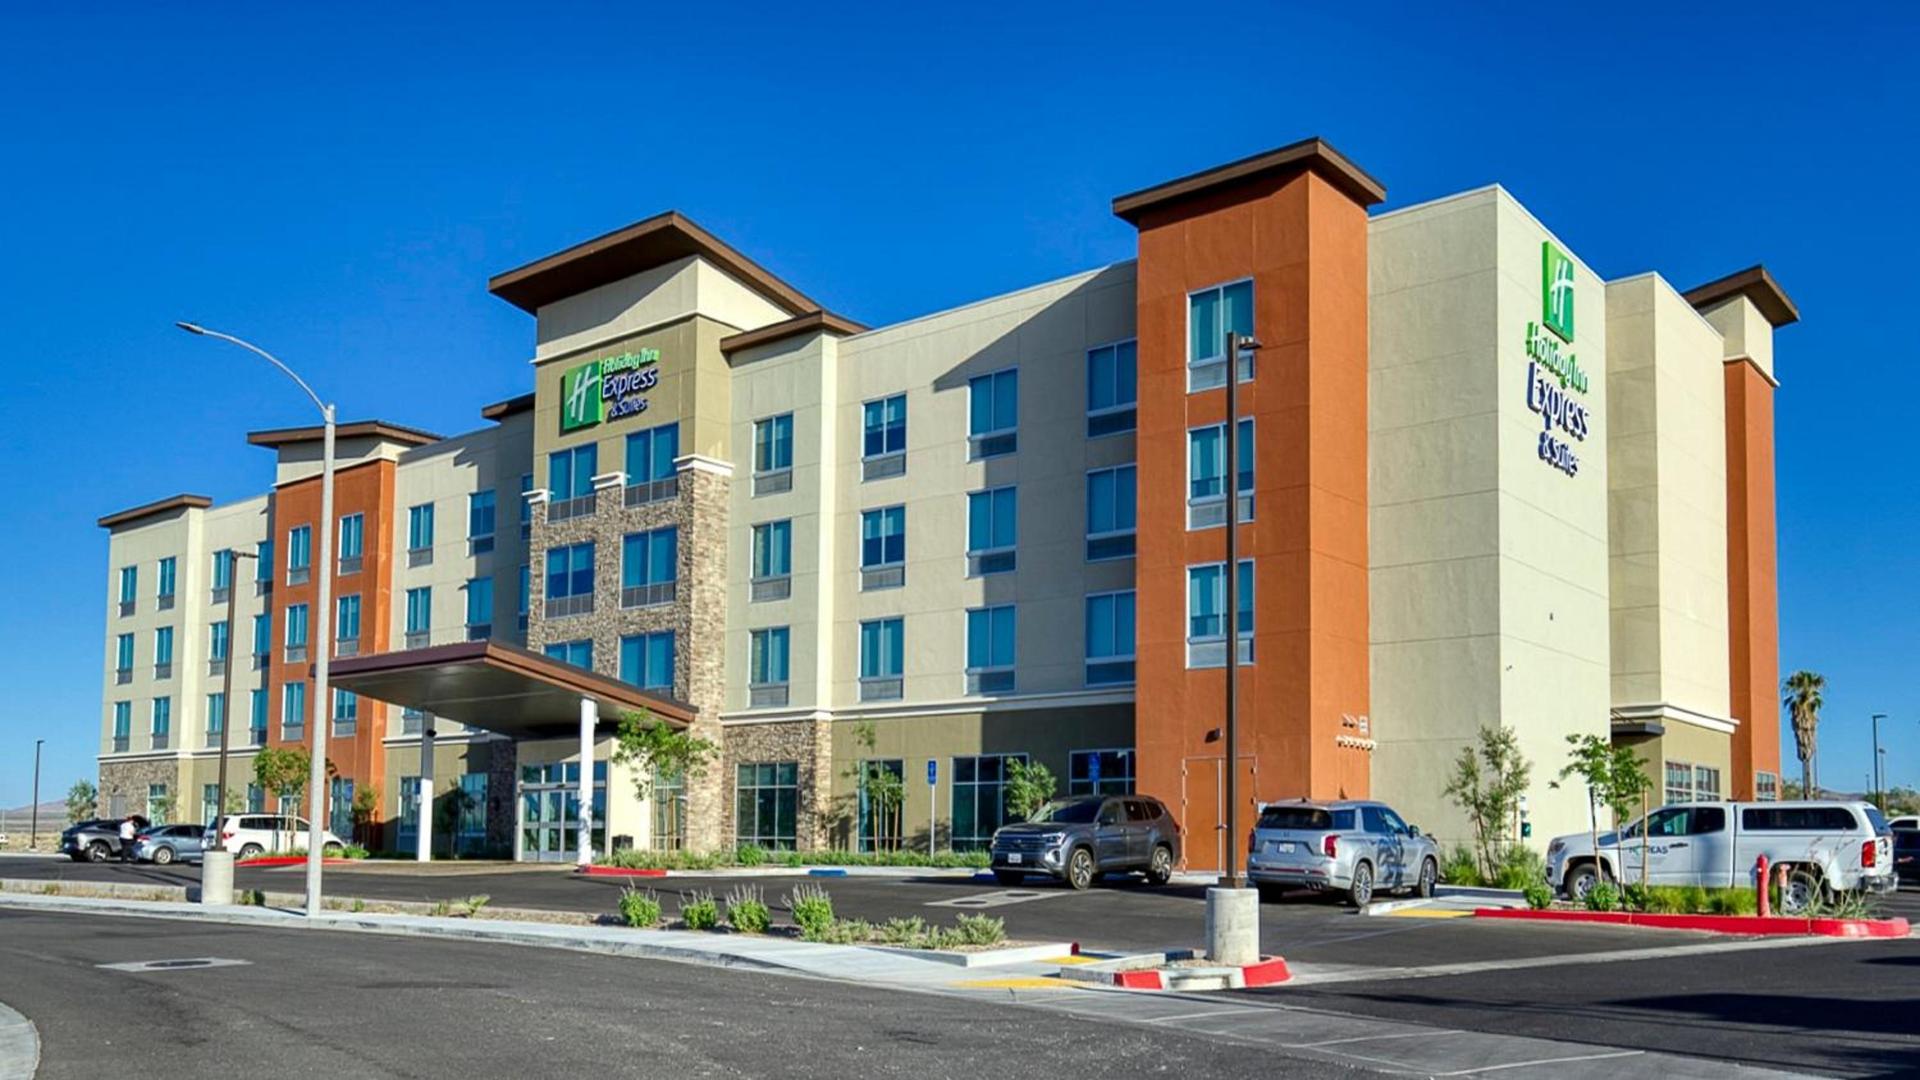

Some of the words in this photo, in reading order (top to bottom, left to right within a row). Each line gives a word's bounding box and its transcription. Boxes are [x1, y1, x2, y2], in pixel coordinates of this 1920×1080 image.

[603, 352, 640, 374] Holiday
[640, 348, 660, 363] Inn
[1526, 321, 1571, 390] Holiday
[1567, 353, 1589, 394] Inn
[602, 368, 657, 401] Express
[1526, 361, 1590, 442] Express
[618, 397, 647, 416] Suites
[1547, 436, 1580, 479] Suites
